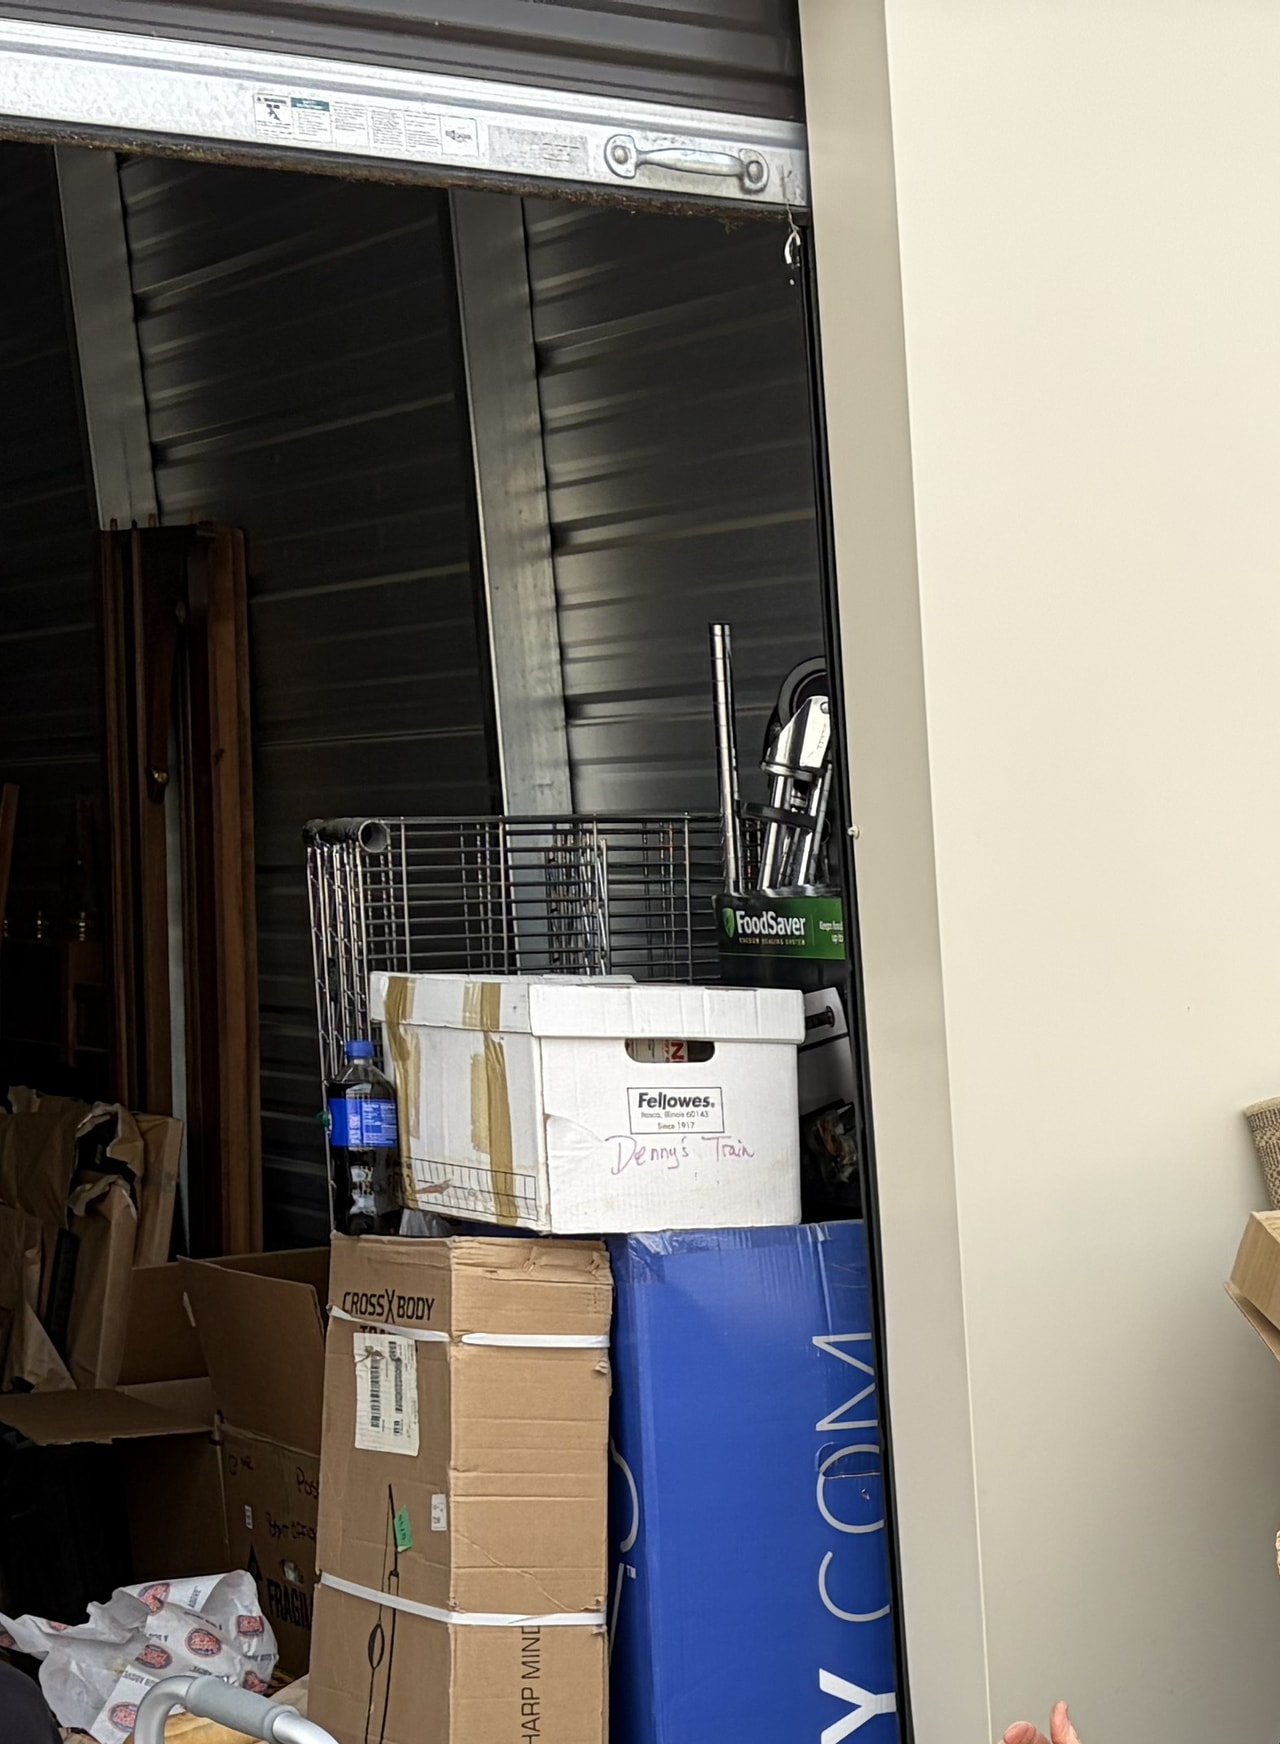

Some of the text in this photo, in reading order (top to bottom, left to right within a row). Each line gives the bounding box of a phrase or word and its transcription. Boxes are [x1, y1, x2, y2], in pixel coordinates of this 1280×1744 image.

[735, 910, 806, 936] FoodSaver
[657, 1122, 676, 1130] Since
[605, 1136, 755, 1175] Denny's Train
